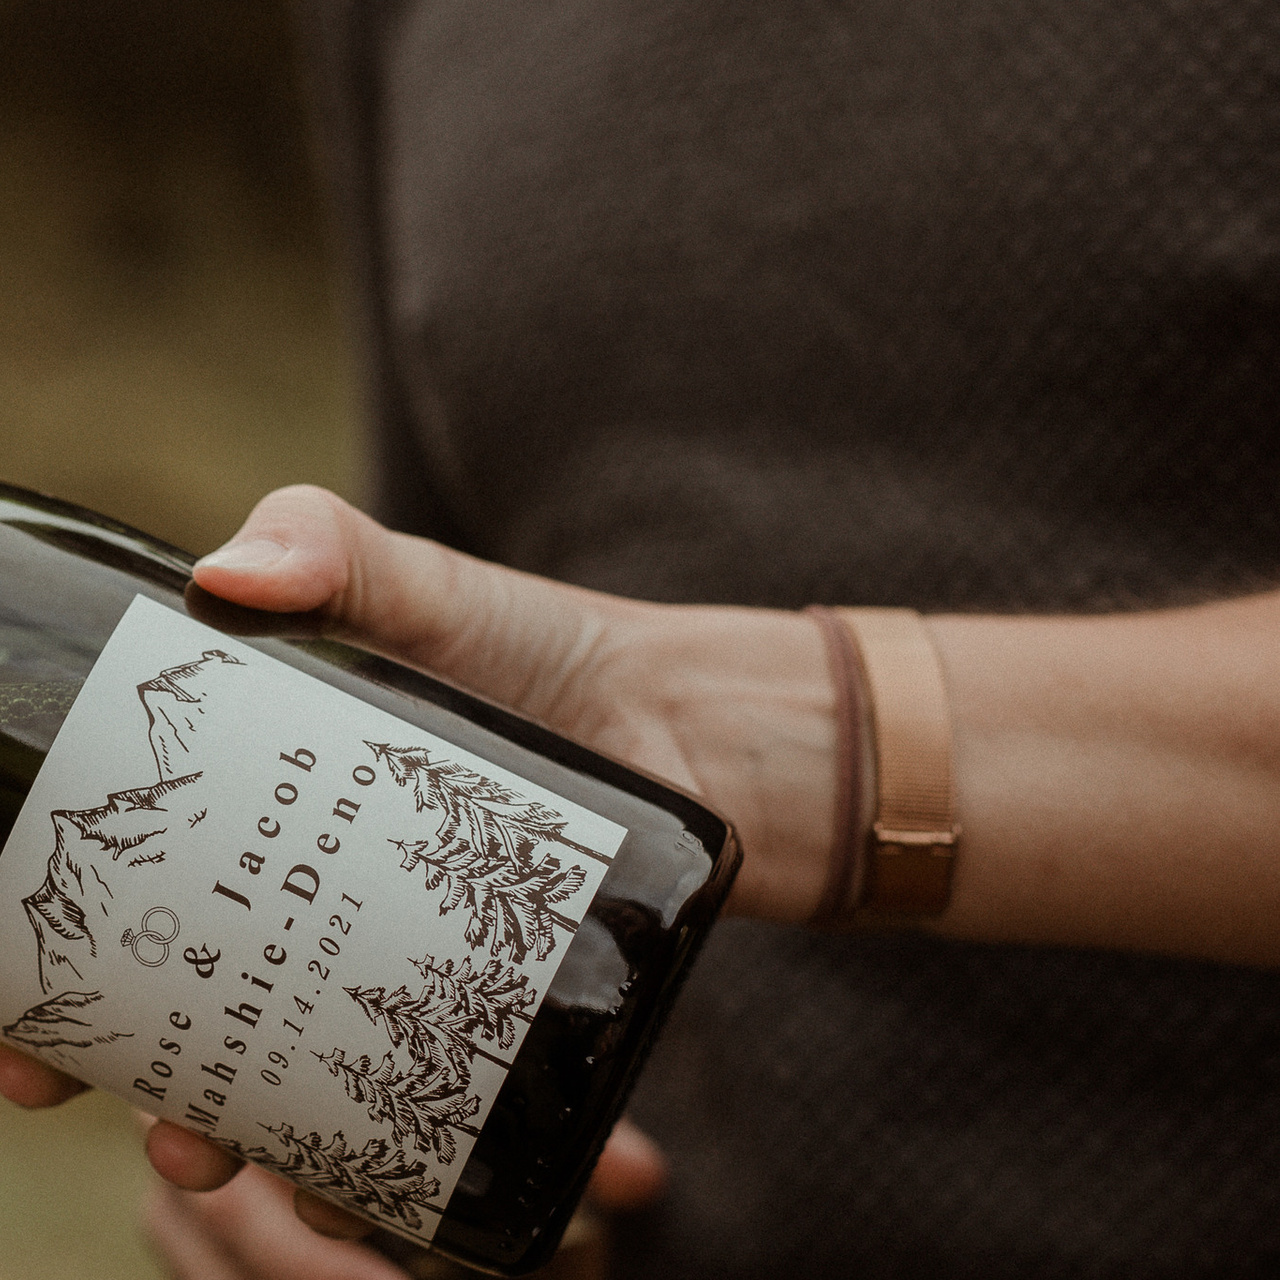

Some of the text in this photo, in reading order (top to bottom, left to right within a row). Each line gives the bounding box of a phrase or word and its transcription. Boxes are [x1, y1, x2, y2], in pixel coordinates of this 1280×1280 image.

[132, 746, 317, 1101] Rose & Jacob
[185, 765, 377, 1132] Mahshie-Deno
[260, 892, 364, 1086] 09.14.2021
